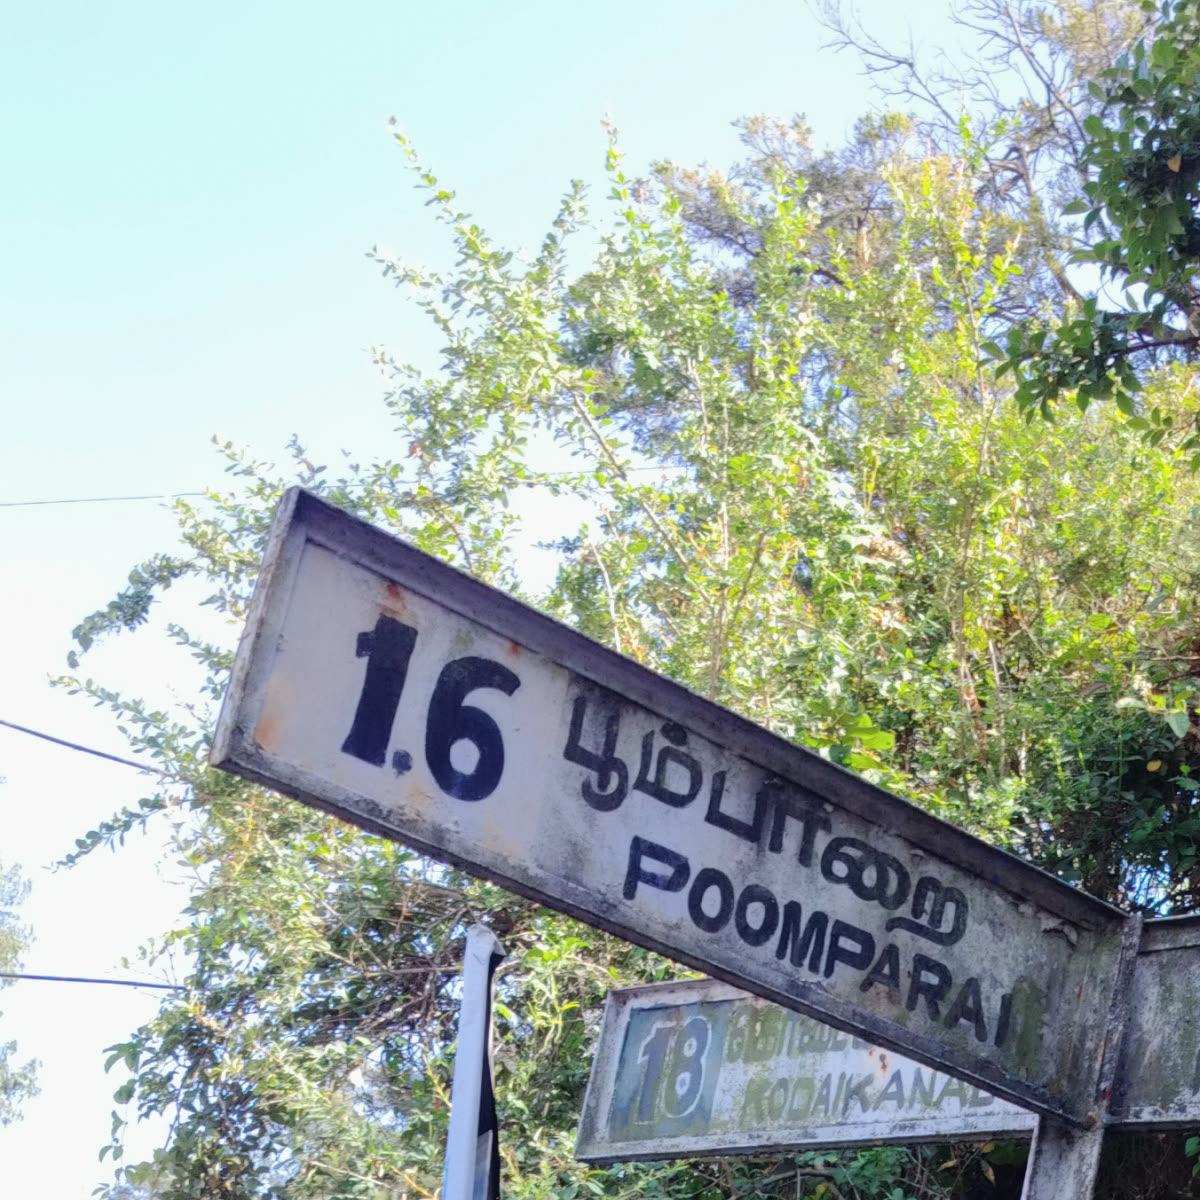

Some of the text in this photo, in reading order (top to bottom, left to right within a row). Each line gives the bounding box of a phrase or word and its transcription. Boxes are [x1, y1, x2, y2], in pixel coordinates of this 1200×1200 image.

[340, 612, 522, 803] 1.6
[563, 696, 969, 947] பூம்பாறை
[622, 835, 1012, 1049] POOMPARAI
[635, 1015, 712, 1125] 18
